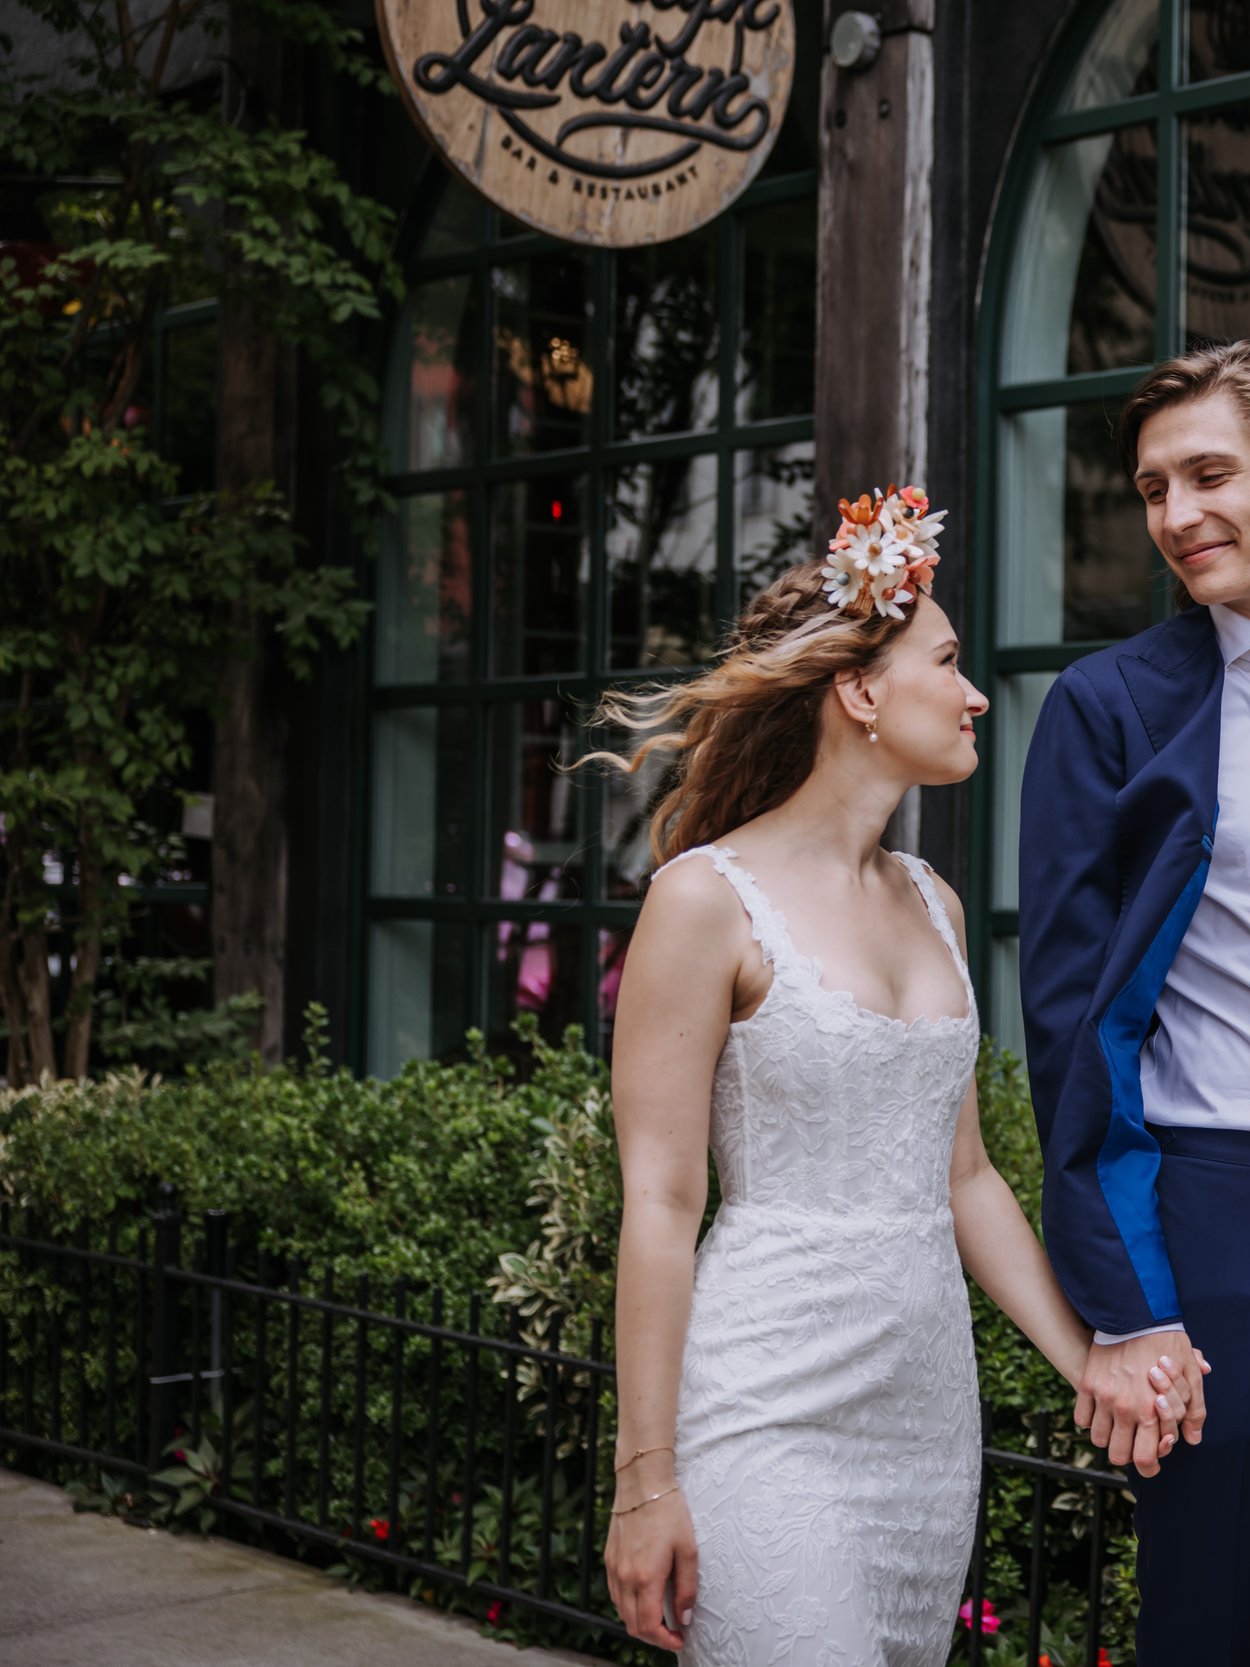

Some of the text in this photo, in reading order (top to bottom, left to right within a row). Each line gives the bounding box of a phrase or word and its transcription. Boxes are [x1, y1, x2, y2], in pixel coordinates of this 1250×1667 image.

[414, 0, 770, 150] Lantern
[501, 134, 699, 201] BAR & RESTAURANT
